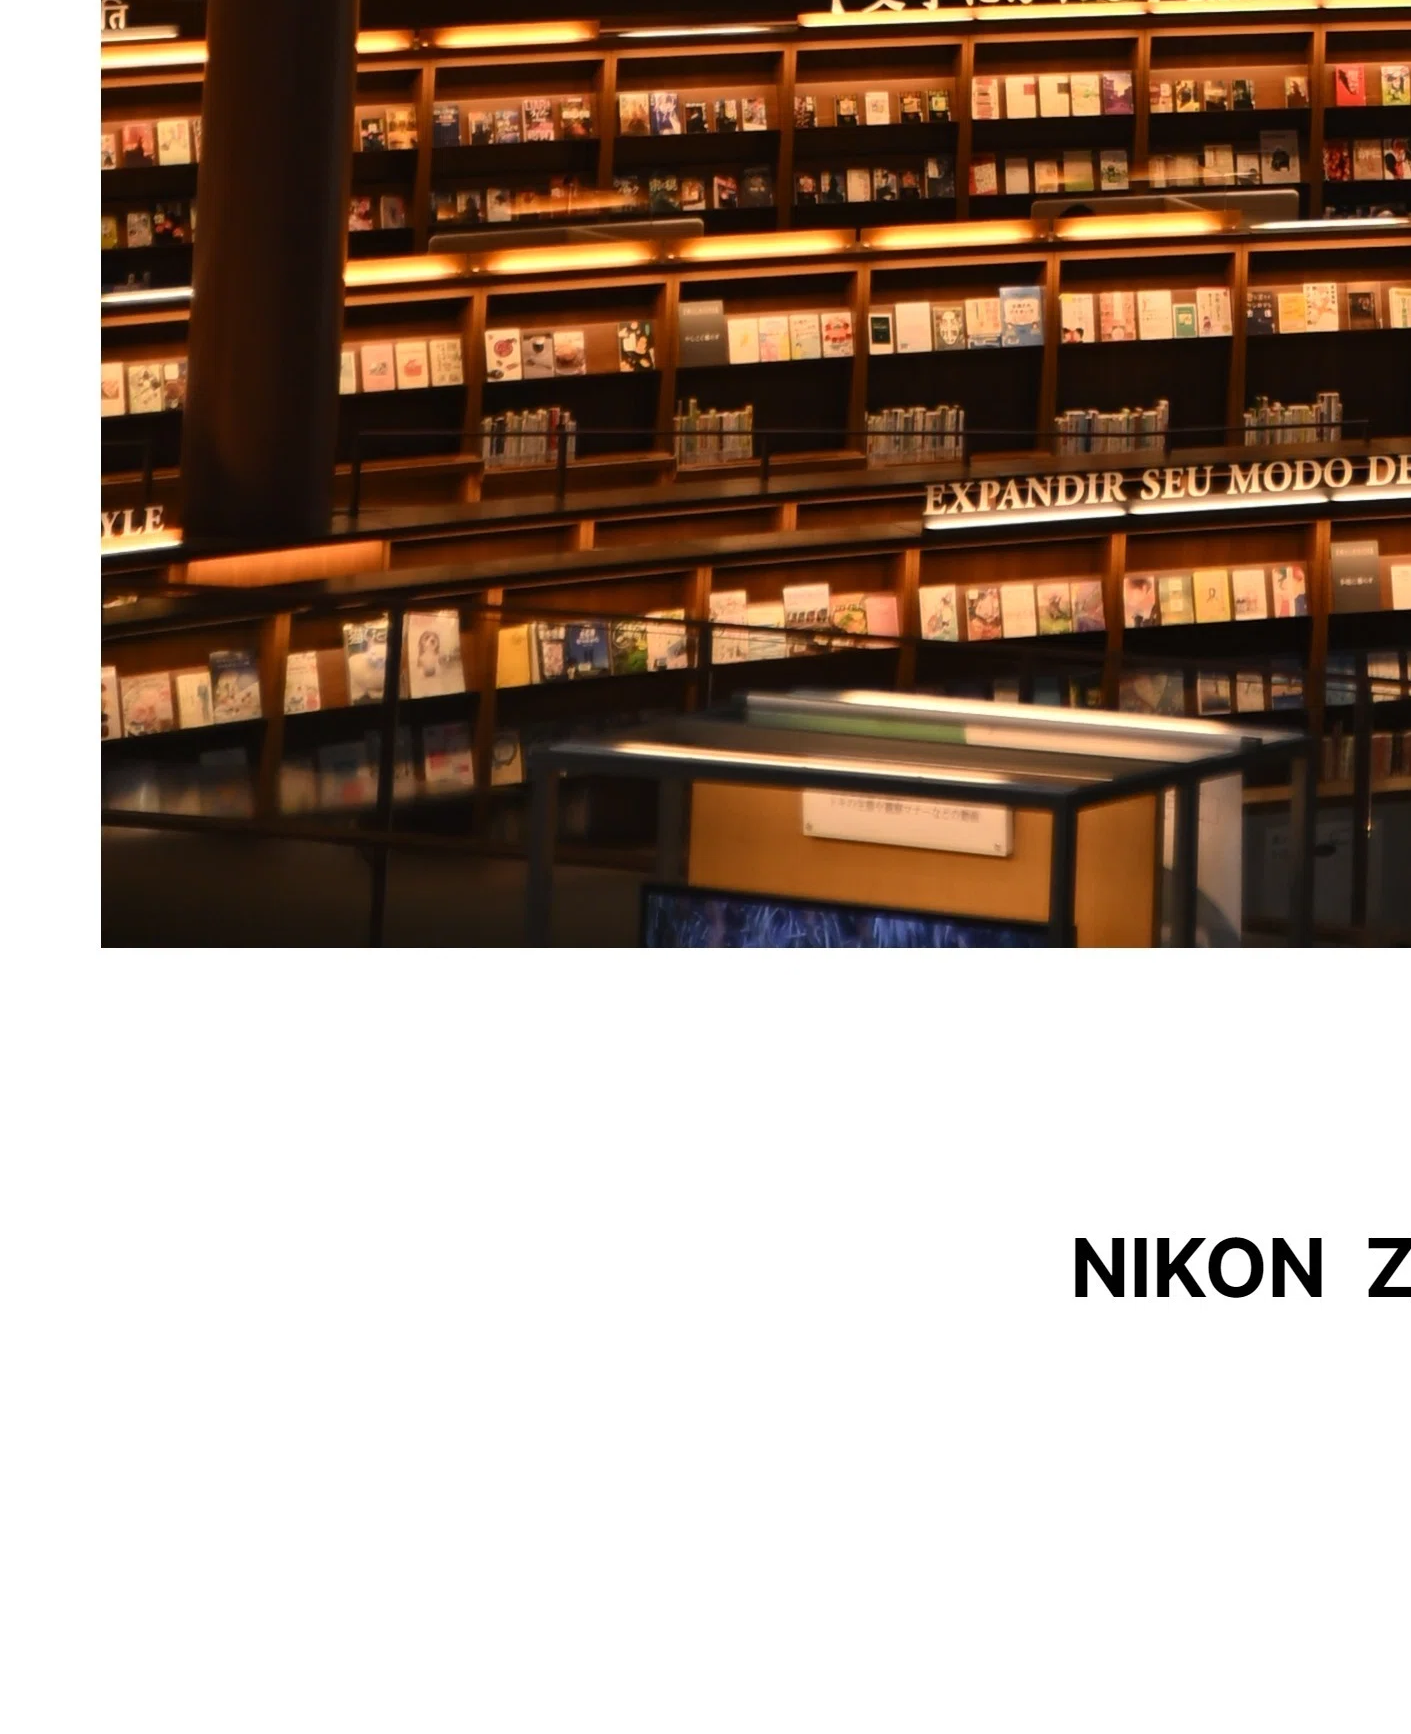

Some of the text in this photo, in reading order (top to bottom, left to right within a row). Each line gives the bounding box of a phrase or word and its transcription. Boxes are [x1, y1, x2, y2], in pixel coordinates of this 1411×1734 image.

[923, 471, 1127, 517] EXPANDIR
[1139, 463, 1214, 501] SEU
[1225, 457, 1354, 496] MODO
